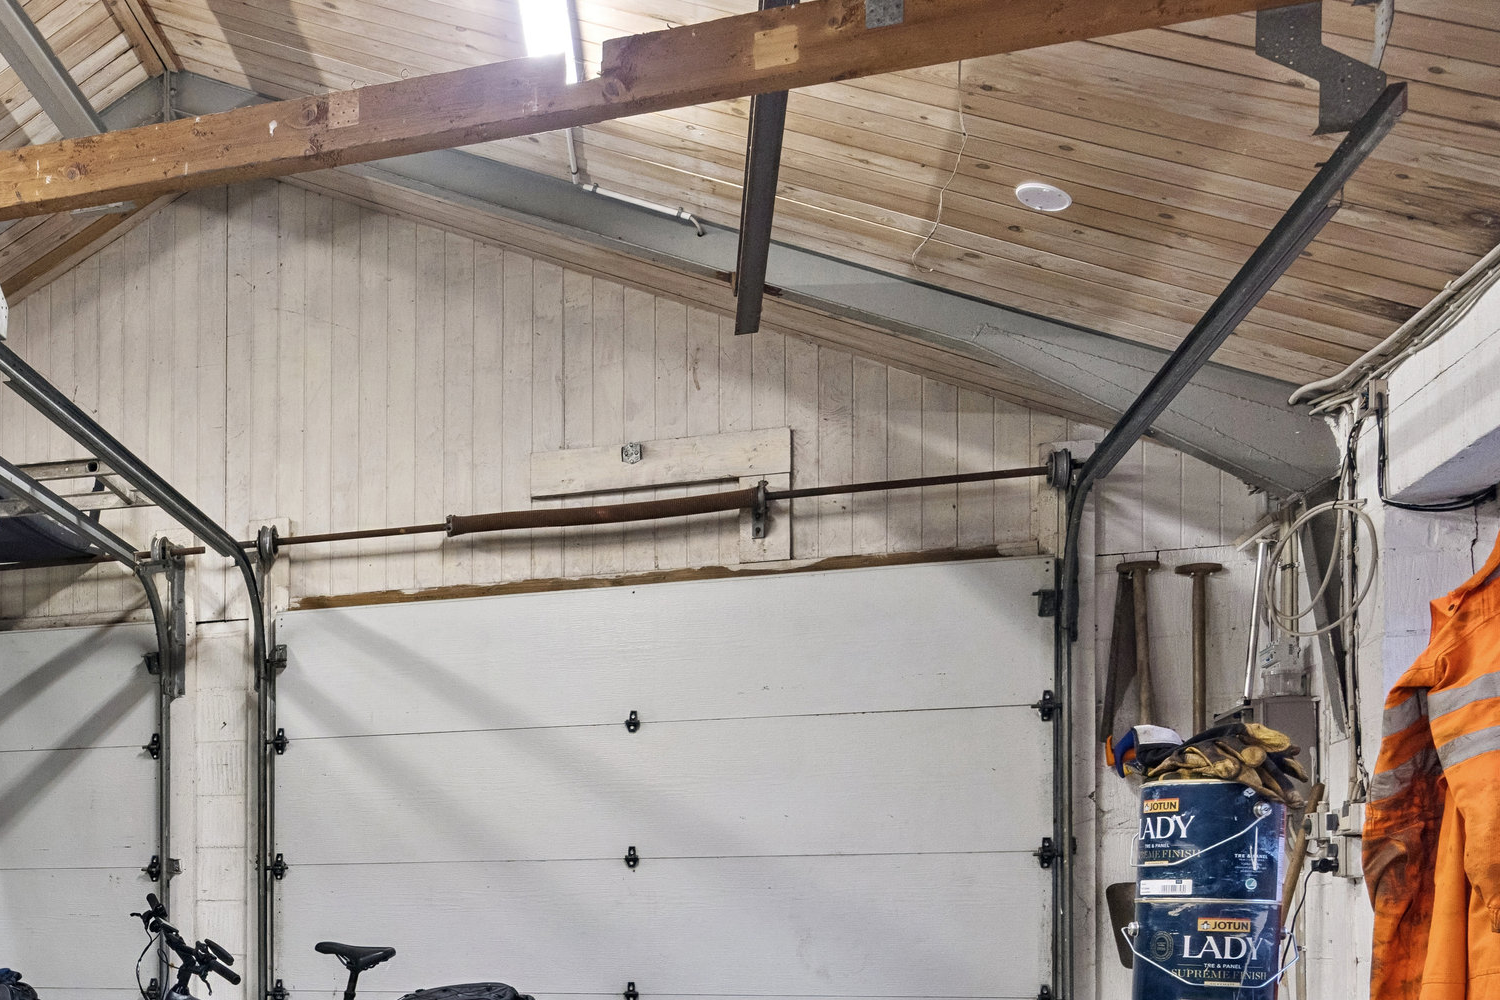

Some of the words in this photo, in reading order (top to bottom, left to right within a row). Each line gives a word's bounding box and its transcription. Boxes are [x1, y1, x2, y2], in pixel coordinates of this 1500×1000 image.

[1149, 802, 1177, 811] JOTUN
[1162, 849, 1201, 859] FINISH
[1212, 921, 1248, 930] JOTUN
[1182, 935, 1263, 960] LADY
[1171, 968, 1230, 980] SUPREME
[1233, 970, 1267, 981] FINISH
